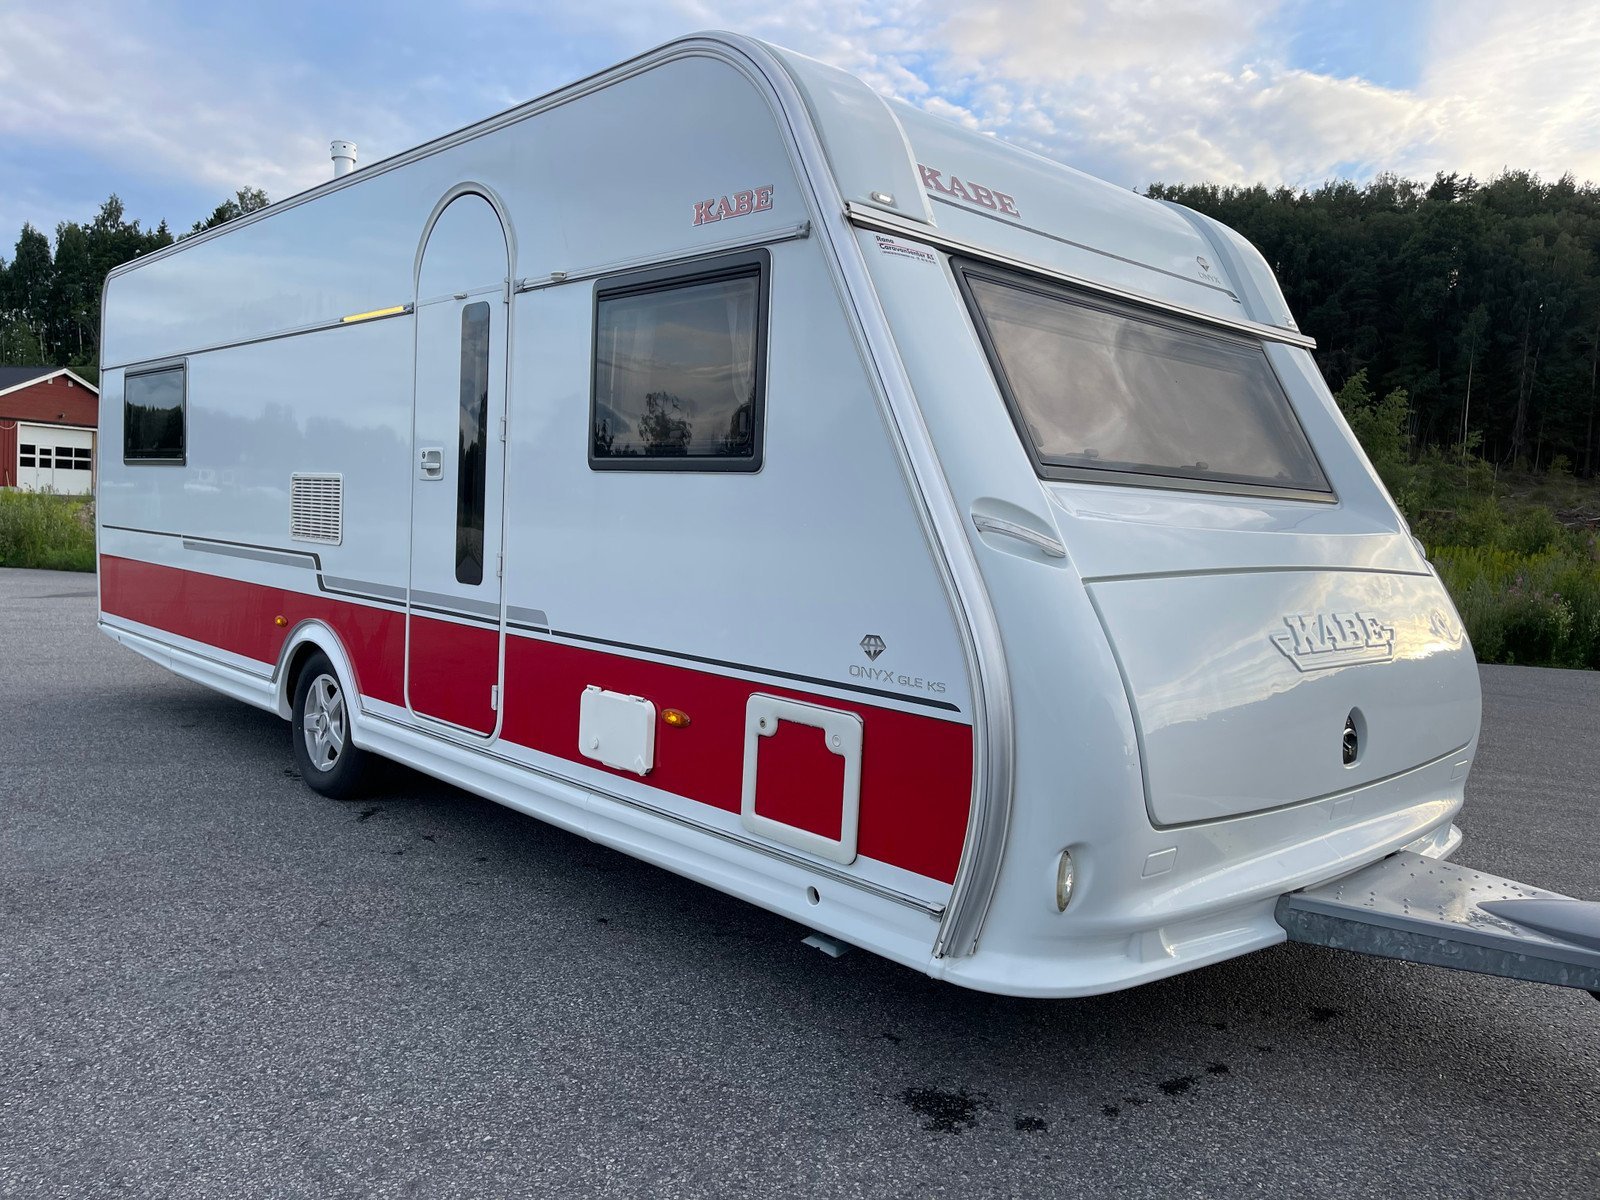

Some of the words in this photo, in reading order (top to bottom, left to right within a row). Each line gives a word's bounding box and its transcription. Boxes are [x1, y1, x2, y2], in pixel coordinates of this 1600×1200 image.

[692, 184, 774, 227] KABE
[917, 162, 1021, 219] KABE
[1283, 611, 1390, 655] KABE
[849, 664, 894, 684] ONYX
[898, 674, 923, 689] GLE
[927, 681, 946, 693] KS
